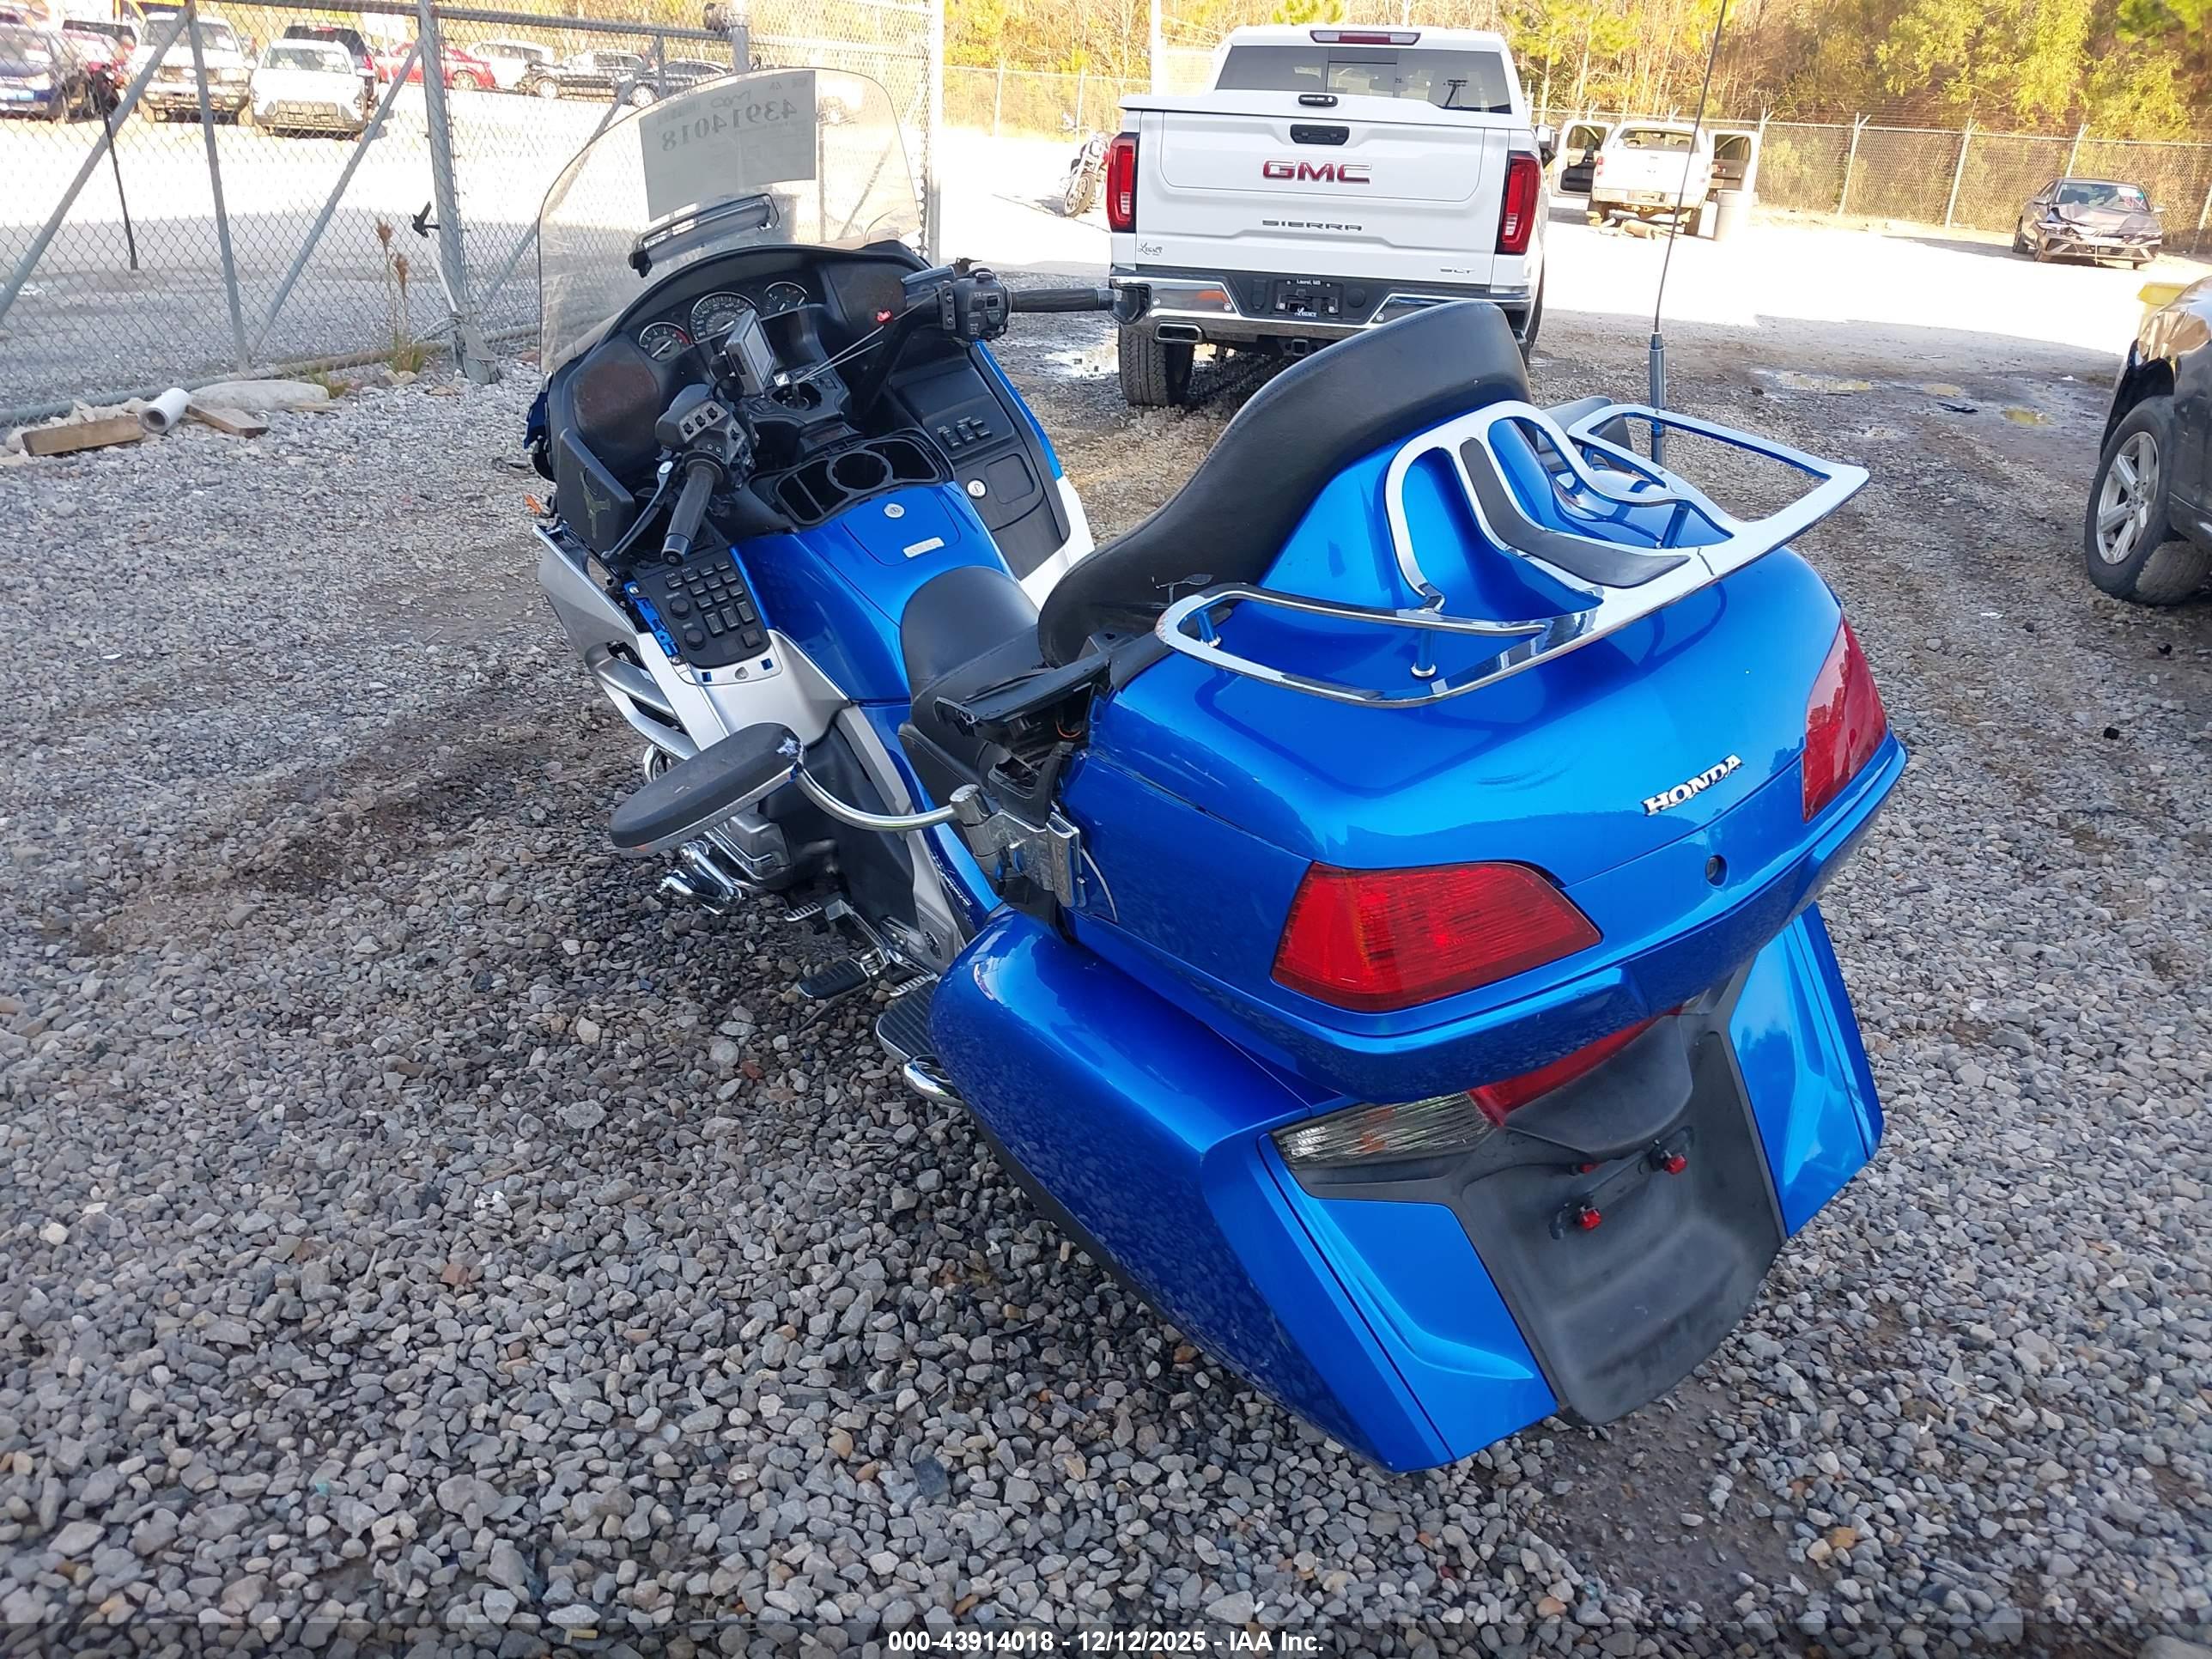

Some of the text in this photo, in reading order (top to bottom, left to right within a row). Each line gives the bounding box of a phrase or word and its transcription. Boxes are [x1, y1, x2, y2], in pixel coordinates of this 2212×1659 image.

[1262, 159, 1372, 185] GMC
[1261, 219, 1363, 232] SIERRA
[1642, 754, 1742, 816] HONDA
